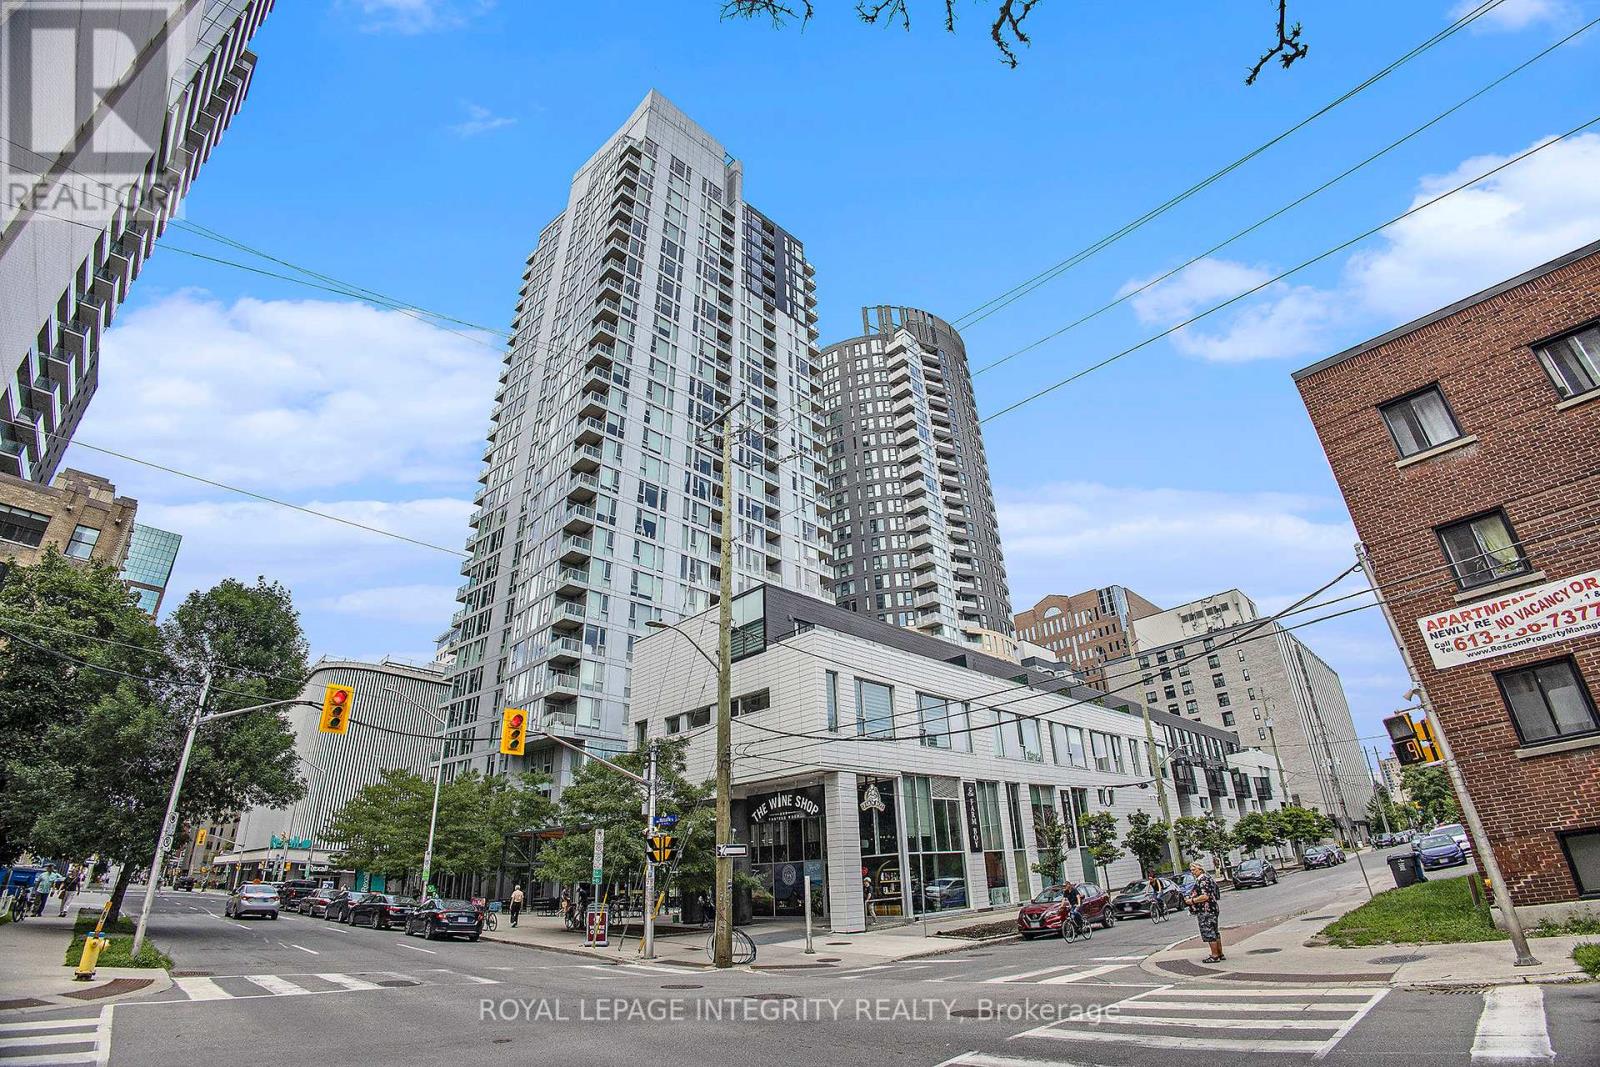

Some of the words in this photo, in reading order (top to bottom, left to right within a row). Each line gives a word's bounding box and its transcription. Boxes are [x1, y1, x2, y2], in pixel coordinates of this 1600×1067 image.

[1494, 614, 1516, 631] NO
[1514, 587, 1571, 621] VACANCY
[1429, 623, 1470, 640] NEWLY
[1434, 640, 1451, 649] Call
[1406, 741, 1420, 760] 9
[751, 802, 768, 822] THE
[768, 792, 793, 810] WINE
[794, 795, 819, 815] SHOP
